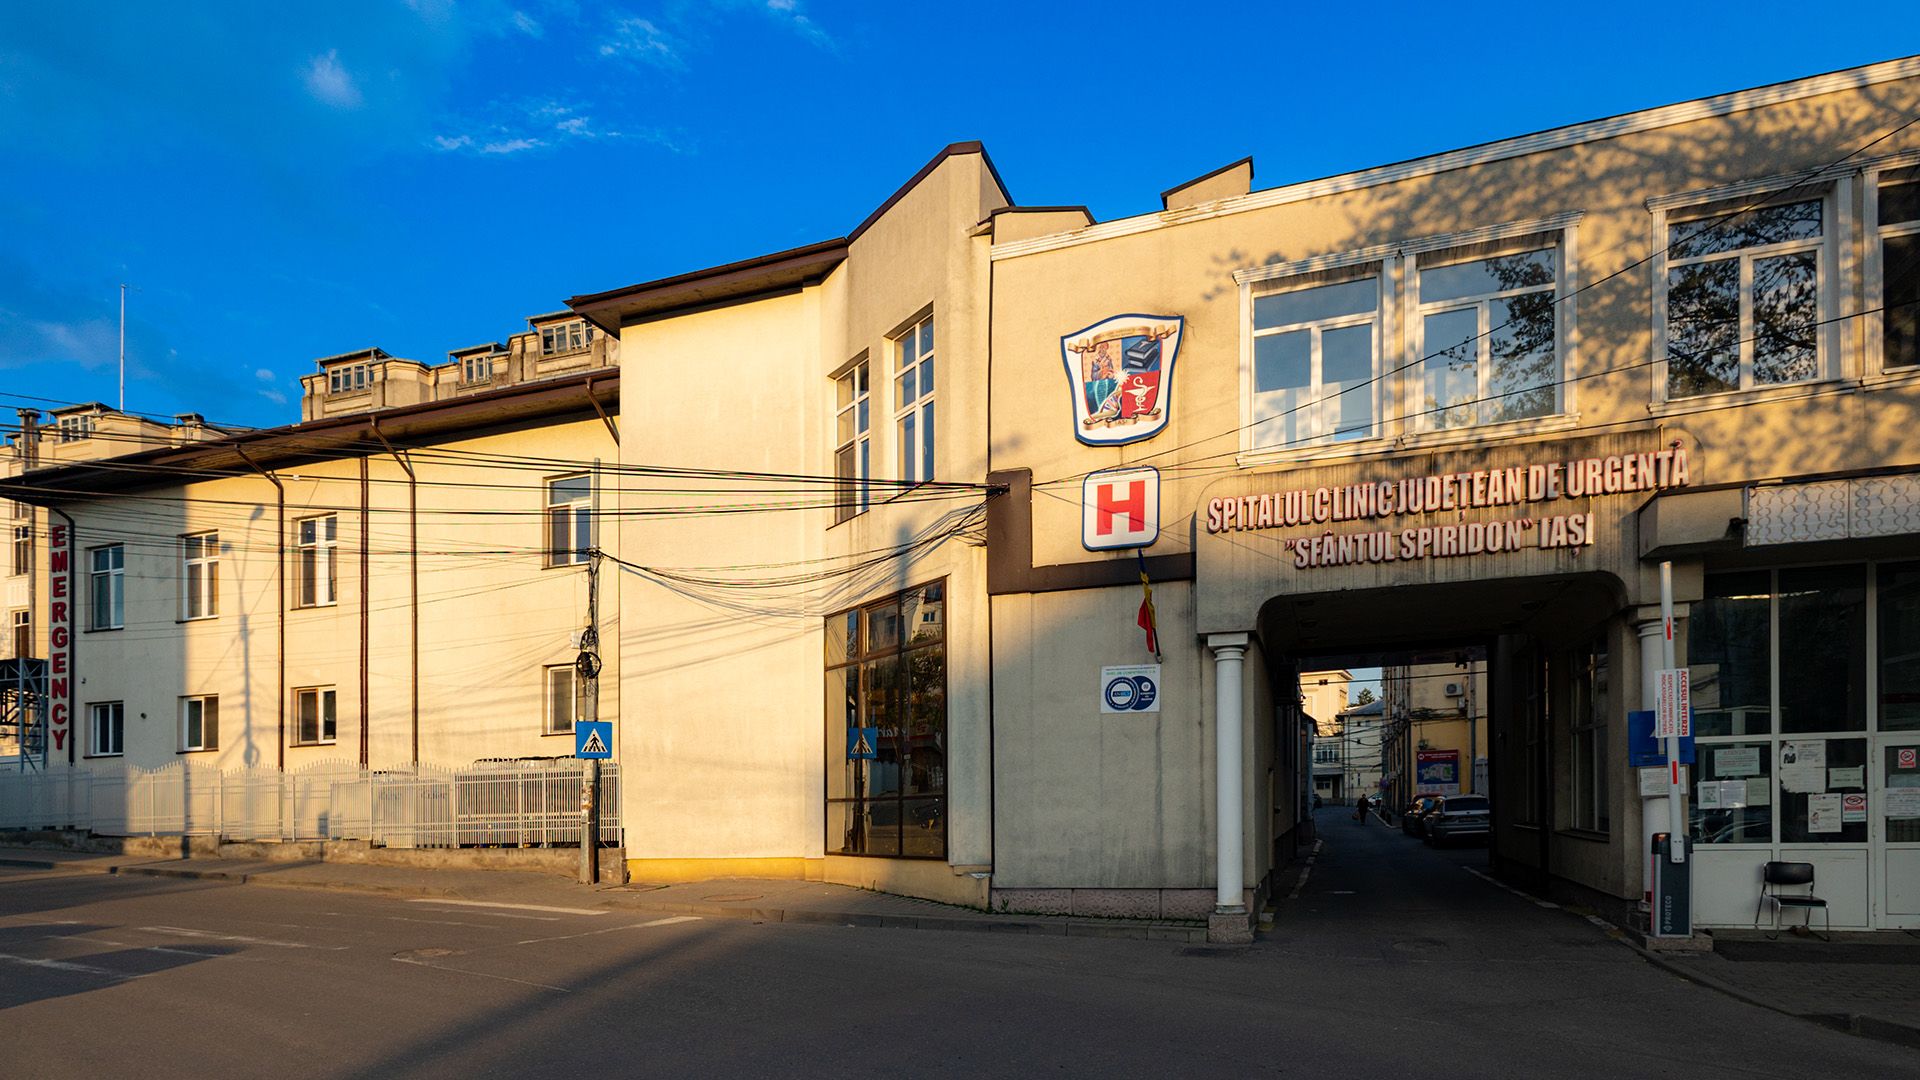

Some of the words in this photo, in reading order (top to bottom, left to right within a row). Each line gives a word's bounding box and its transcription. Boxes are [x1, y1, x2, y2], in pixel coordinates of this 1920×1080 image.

[1097, 480, 1145, 536] H
[1207, 489, 1312, 534] SPITALUL
[1313, 480, 1393, 524] CLINIC
[1528, 462, 1561, 503] DE
[51, 525, 68, 750] EMERGENCY
[1664, 895, 1672, 924] PROTECO
